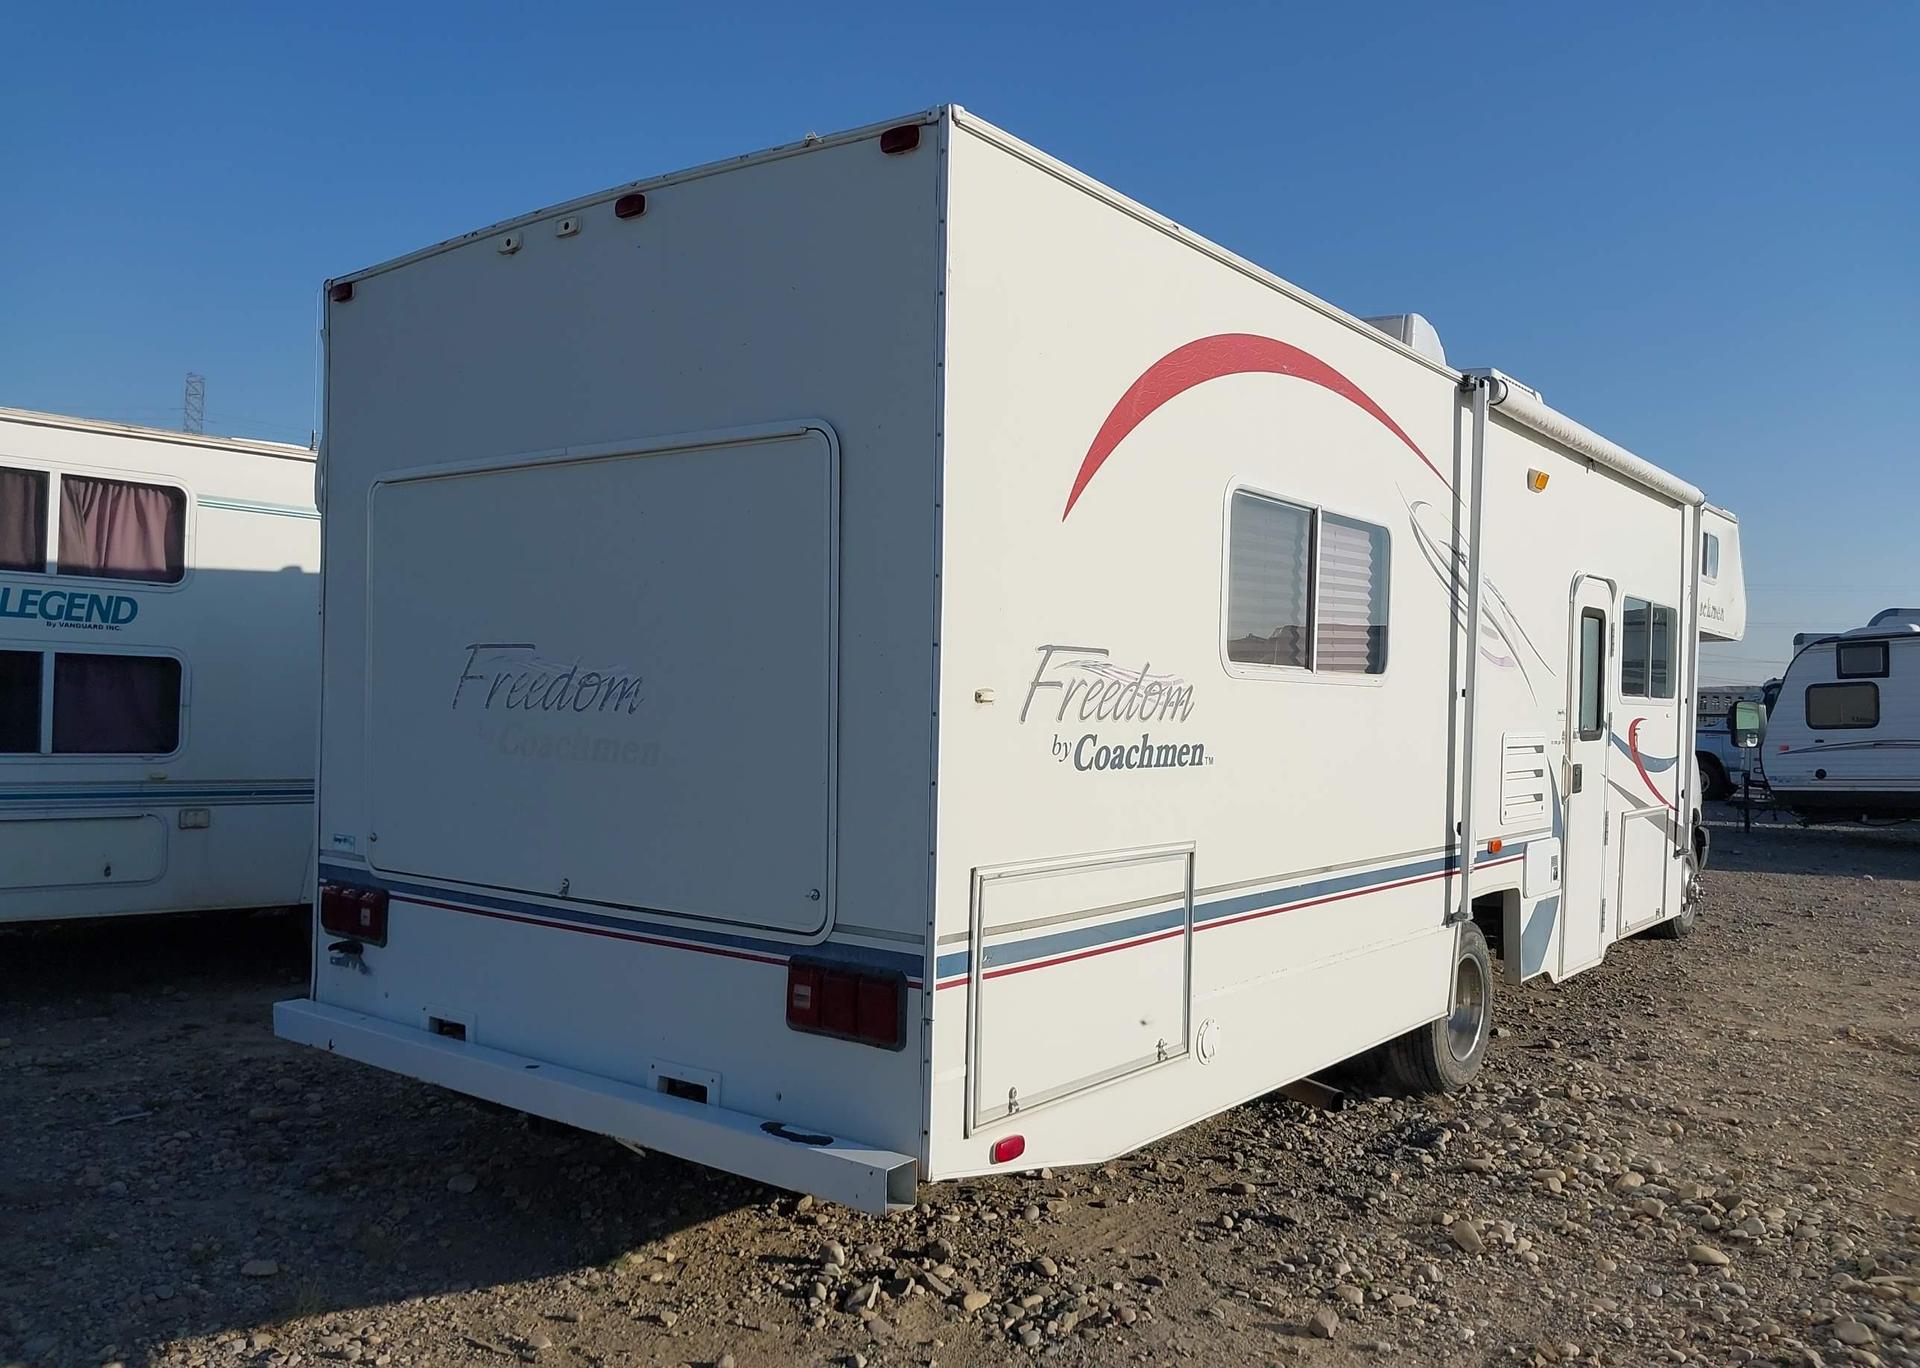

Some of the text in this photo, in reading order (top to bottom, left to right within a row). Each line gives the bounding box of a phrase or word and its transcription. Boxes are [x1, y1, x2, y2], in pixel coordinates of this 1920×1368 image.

[0, 587, 138, 624] LEGEND
[59, 622, 104, 631] VANGUARD
[452, 643, 645, 715] Freedom
[1019, 644, 1195, 723] Freedom
[1051, 734, 1072, 762] by
[1074, 733, 1205, 771] Coachmen
